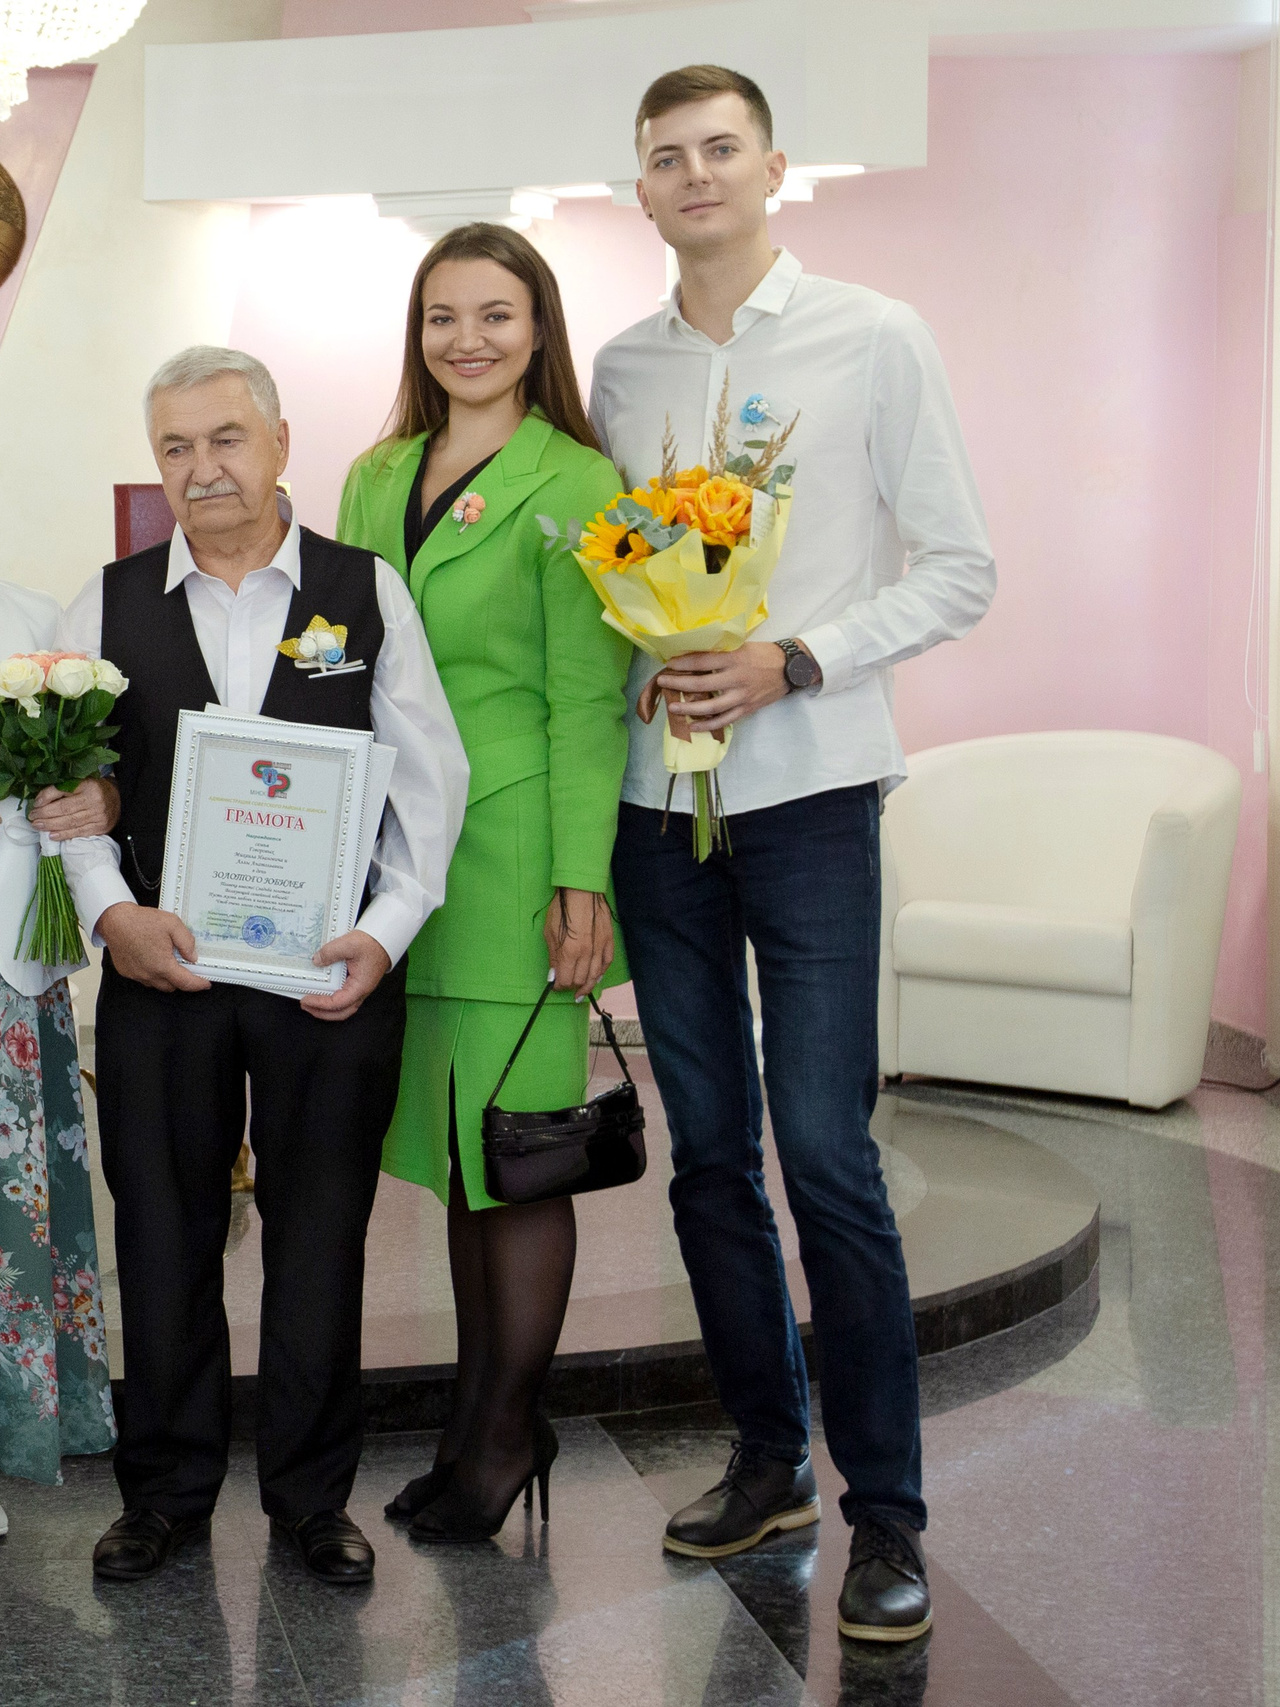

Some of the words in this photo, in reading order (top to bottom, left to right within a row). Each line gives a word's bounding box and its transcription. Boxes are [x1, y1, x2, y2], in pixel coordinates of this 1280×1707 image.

[225, 807, 305, 831] ГРАМОТА
[212, 870, 263, 884] ЗОЛОТОГО
[263, 877, 306, 890] ЮБИЛЕЯ
